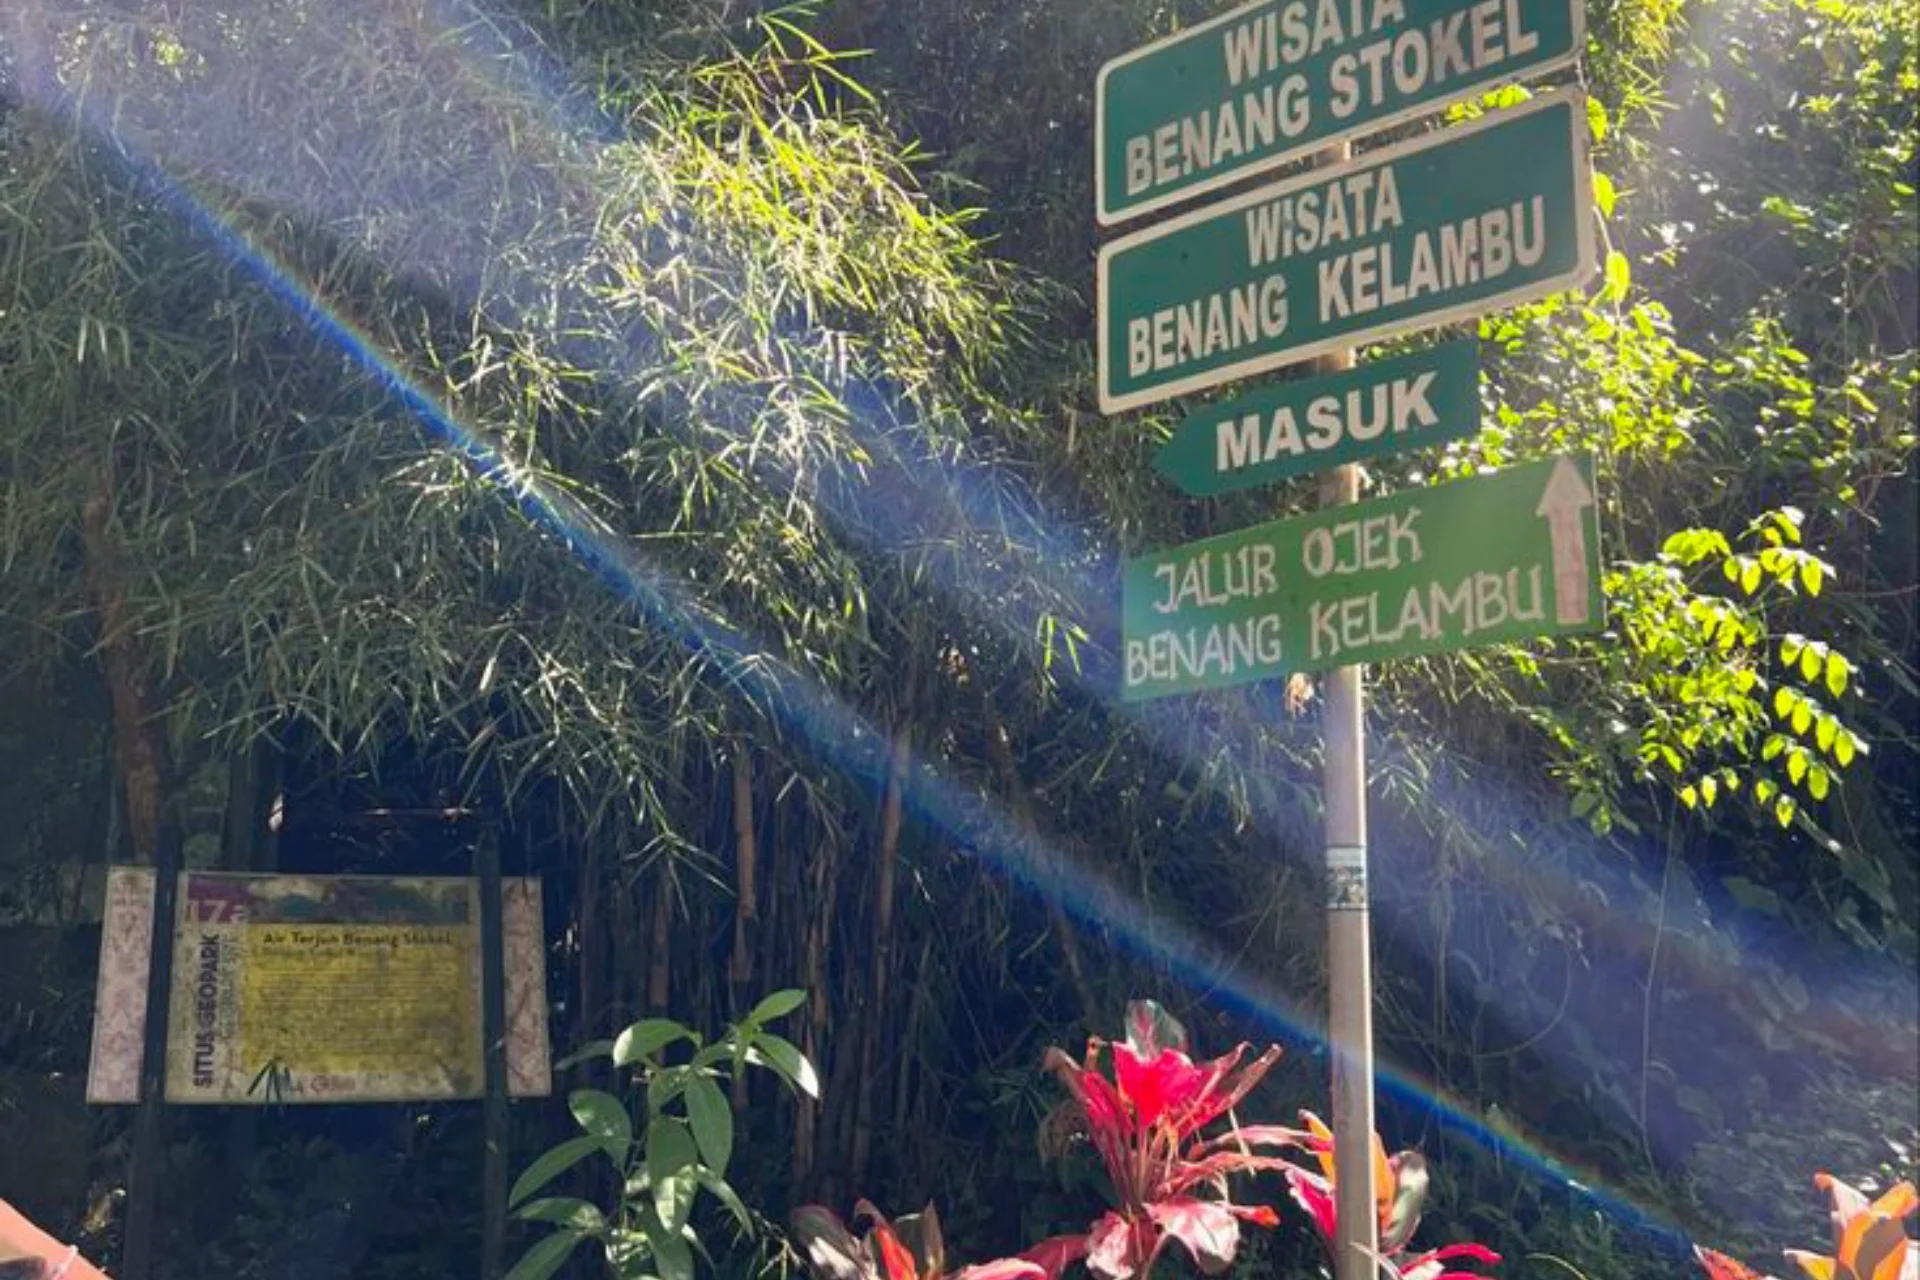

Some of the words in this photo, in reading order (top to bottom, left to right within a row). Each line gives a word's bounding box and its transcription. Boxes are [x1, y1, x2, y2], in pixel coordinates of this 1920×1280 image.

[1126, 75, 1310, 196] BENANG
[1329, 0, 1539, 118] STOKEL
[1245, 165, 1403, 267] WISATA
[1128, 273, 1289, 378] BENANG
[1318, 195, 1546, 322] KELAMBU
[1216, 371, 1440, 472] MASUK
[1153, 543, 1279, 614] JALUR
[1303, 507, 1423, 578] OJEK
[1126, 614, 1281, 686] BENANG
[1309, 563, 1547, 660] KELAMBU
[195, 934, 220, 1030] GEOPARK
[193, 1031, 215, 1088] SITUS
